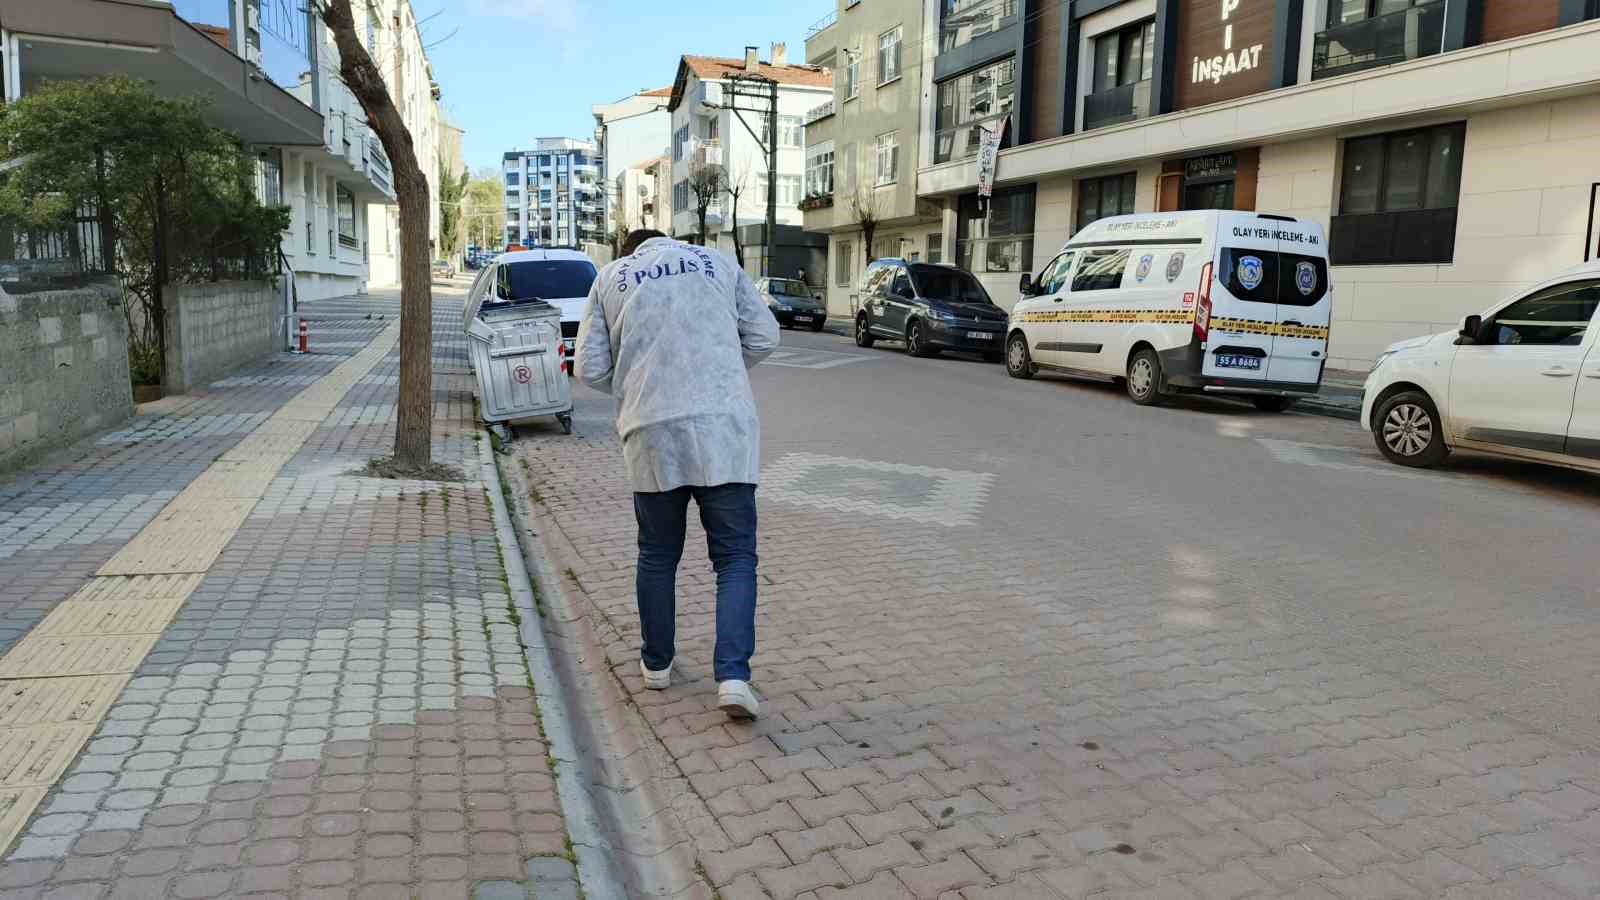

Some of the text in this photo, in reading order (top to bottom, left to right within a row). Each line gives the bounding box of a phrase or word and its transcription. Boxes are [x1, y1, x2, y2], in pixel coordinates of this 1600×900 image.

[1192, 44, 1263, 84] İNŞAAT
[1232, 226, 1252, 237] OLAY
[1253, 228, 1270, 239] YERİ
[1271, 229, 1304, 243] İNCELEME
[617, 263, 630, 292] OLAY
[634, 257, 700, 285] POLİS
[1219, 356, 1229, 365] 55
[1230, 357, 1237, 366] A
